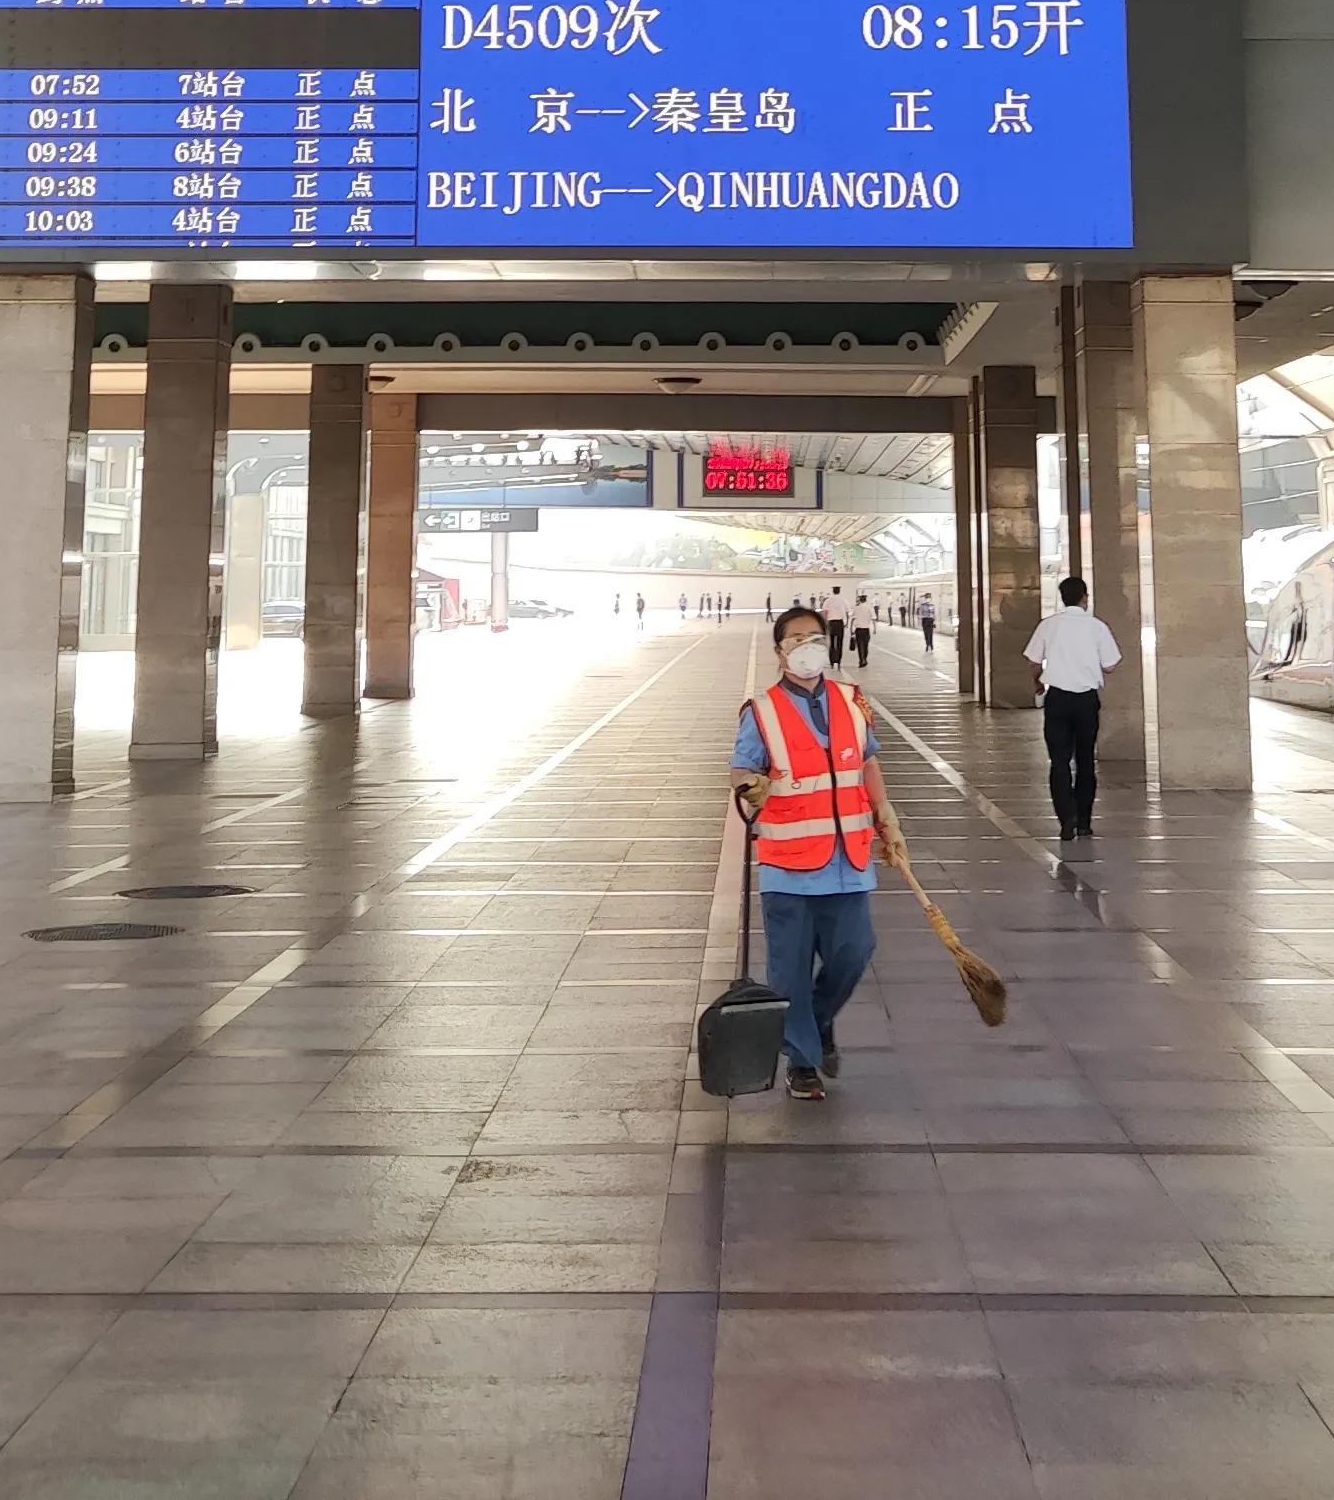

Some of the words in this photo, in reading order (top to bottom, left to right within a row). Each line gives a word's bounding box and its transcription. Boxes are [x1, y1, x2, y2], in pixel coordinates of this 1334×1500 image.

[30, 74, 100, 96] 07:52
[178, 71, 245, 98] 7站台
[29, 108, 98, 129] 09:11
[175, 105, 244, 131] 4站台
[27, 141, 98, 163] 09:24
[174, 138, 243, 165] 6站台
[26, 176, 97, 197] 09:38
[173, 172, 242, 199] 8站台
[25, 210, 93, 232] 10:03
[171, 206, 241, 234] 4站台
